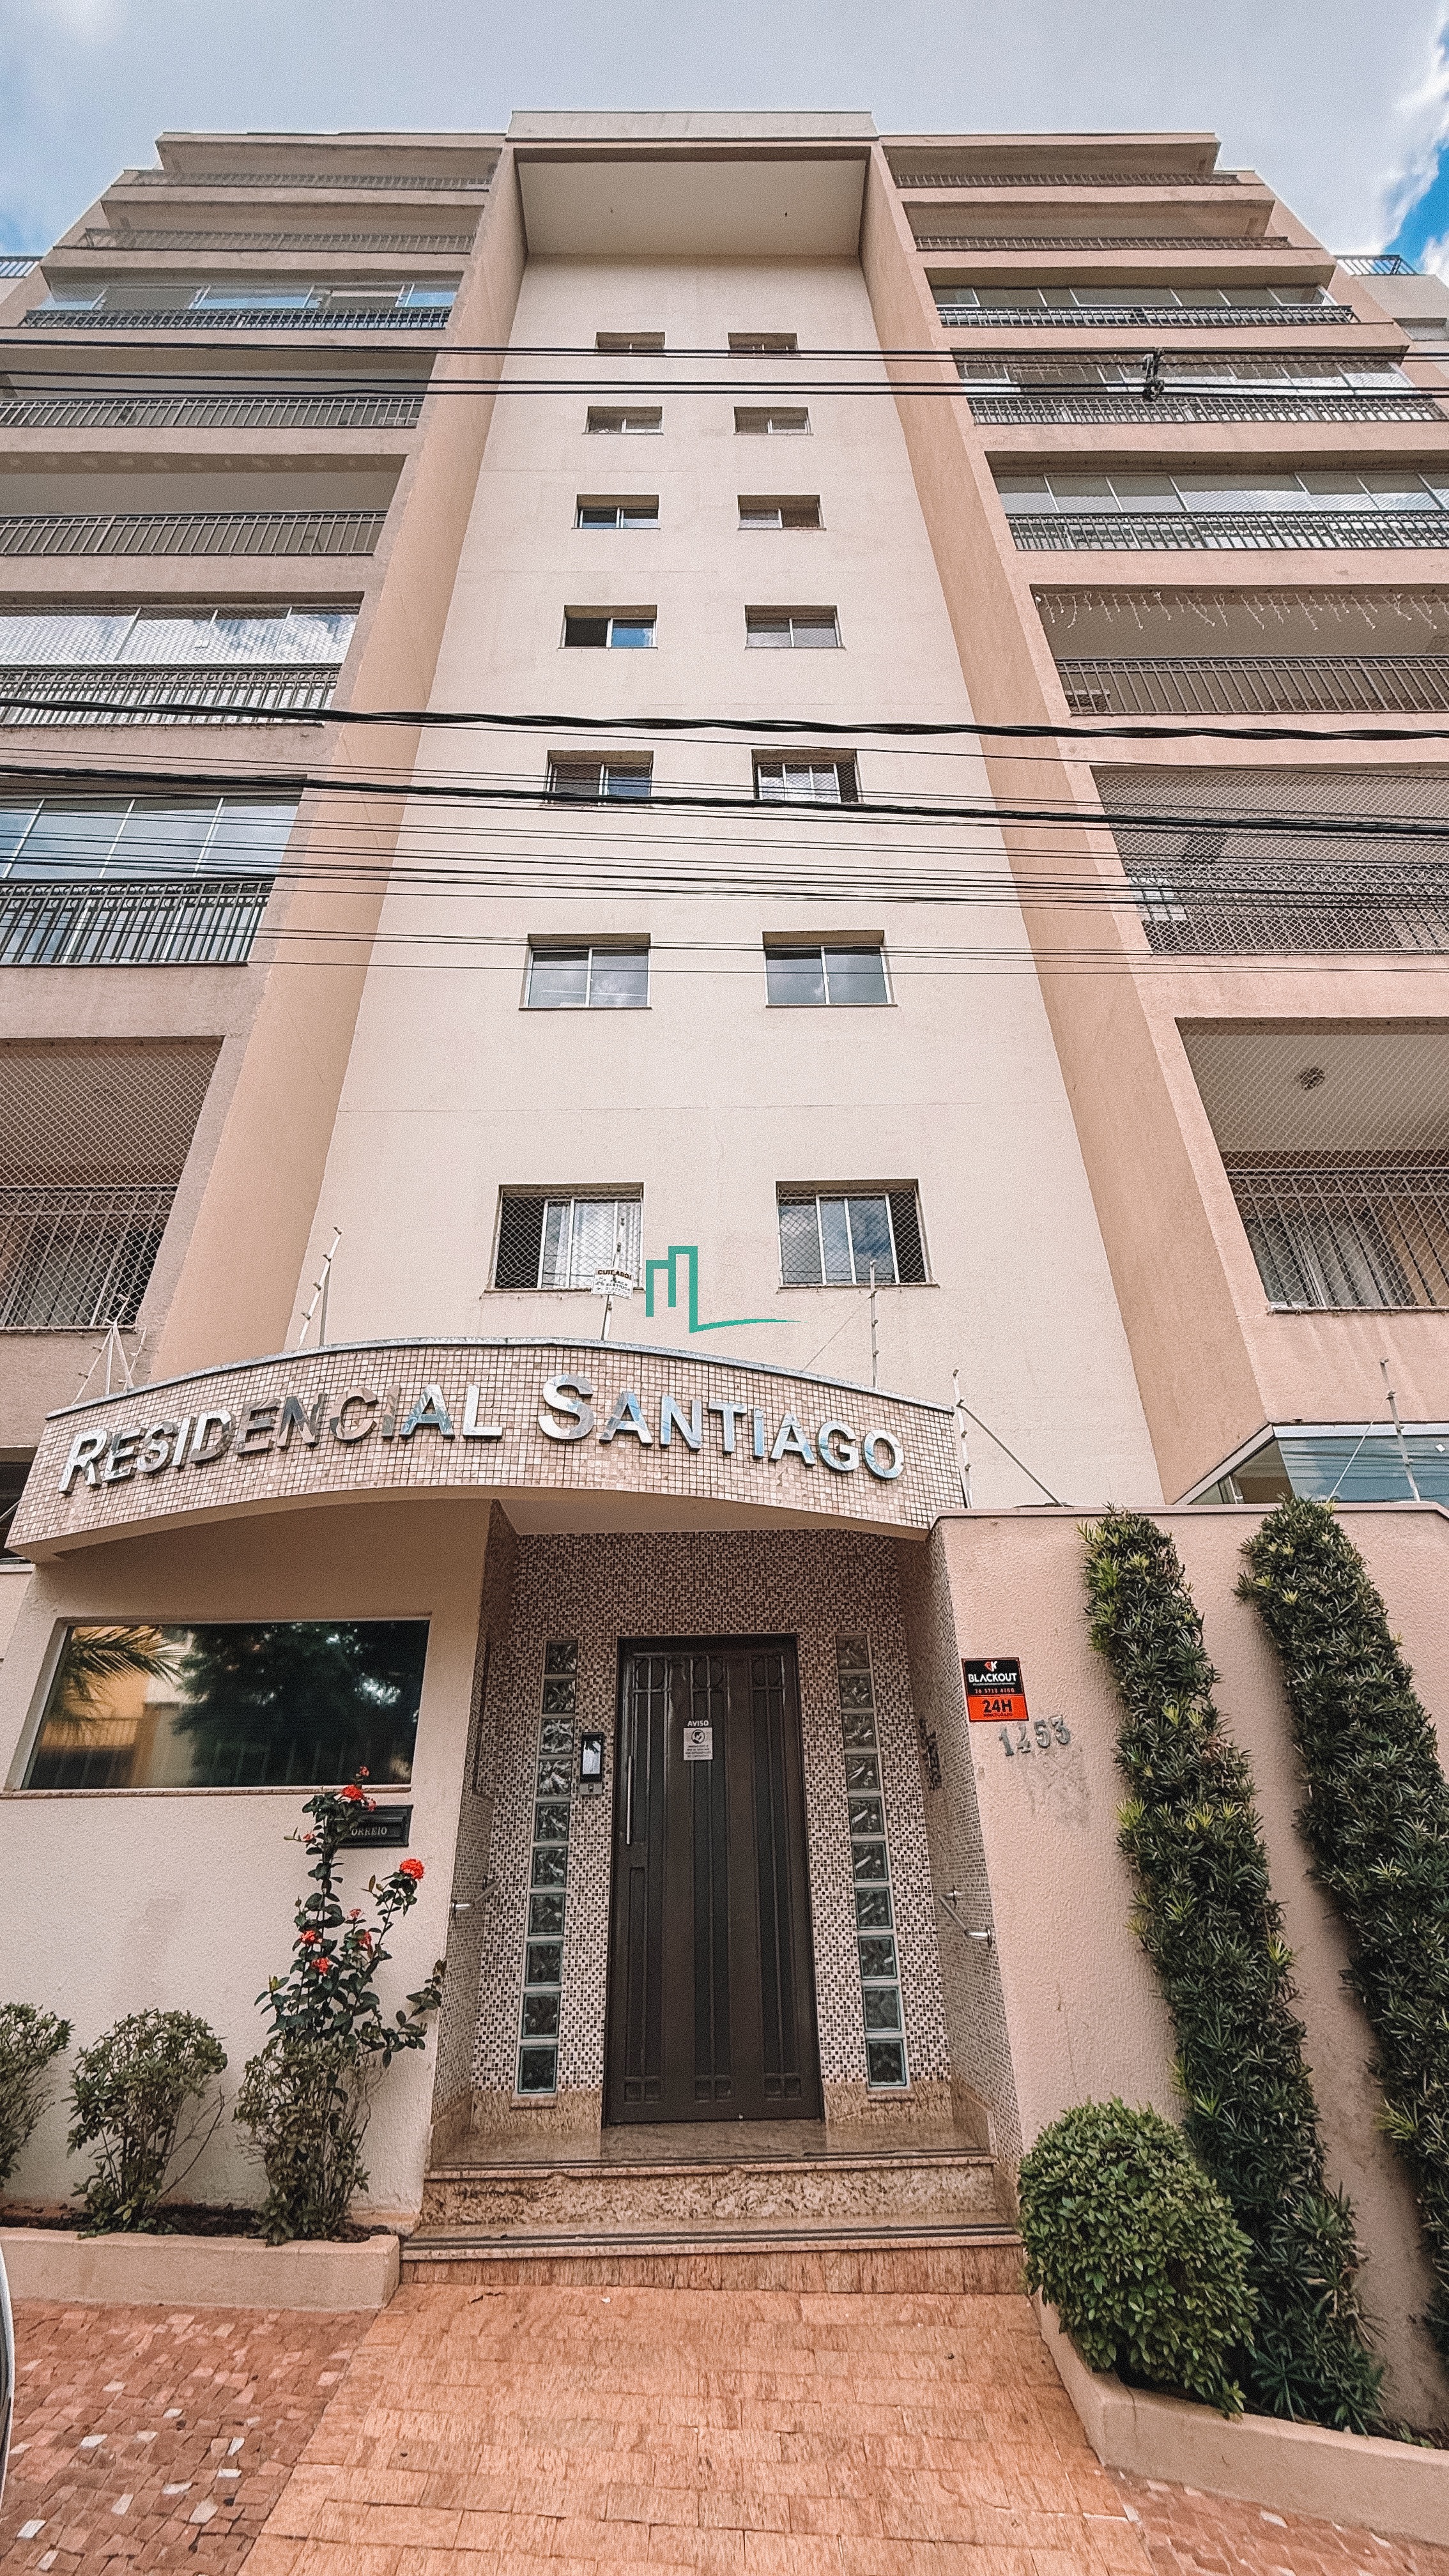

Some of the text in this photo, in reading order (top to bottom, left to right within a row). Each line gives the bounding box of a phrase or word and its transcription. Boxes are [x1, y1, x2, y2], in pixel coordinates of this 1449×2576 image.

[58, 1374, 905, 1496] RESIDENCIAL SANTIAGO
[967, 1673, 1017, 1683] BLACKOUT
[982, 1699, 1013, 1713] 24H
[351, 1827, 387, 1836] ORREIO
